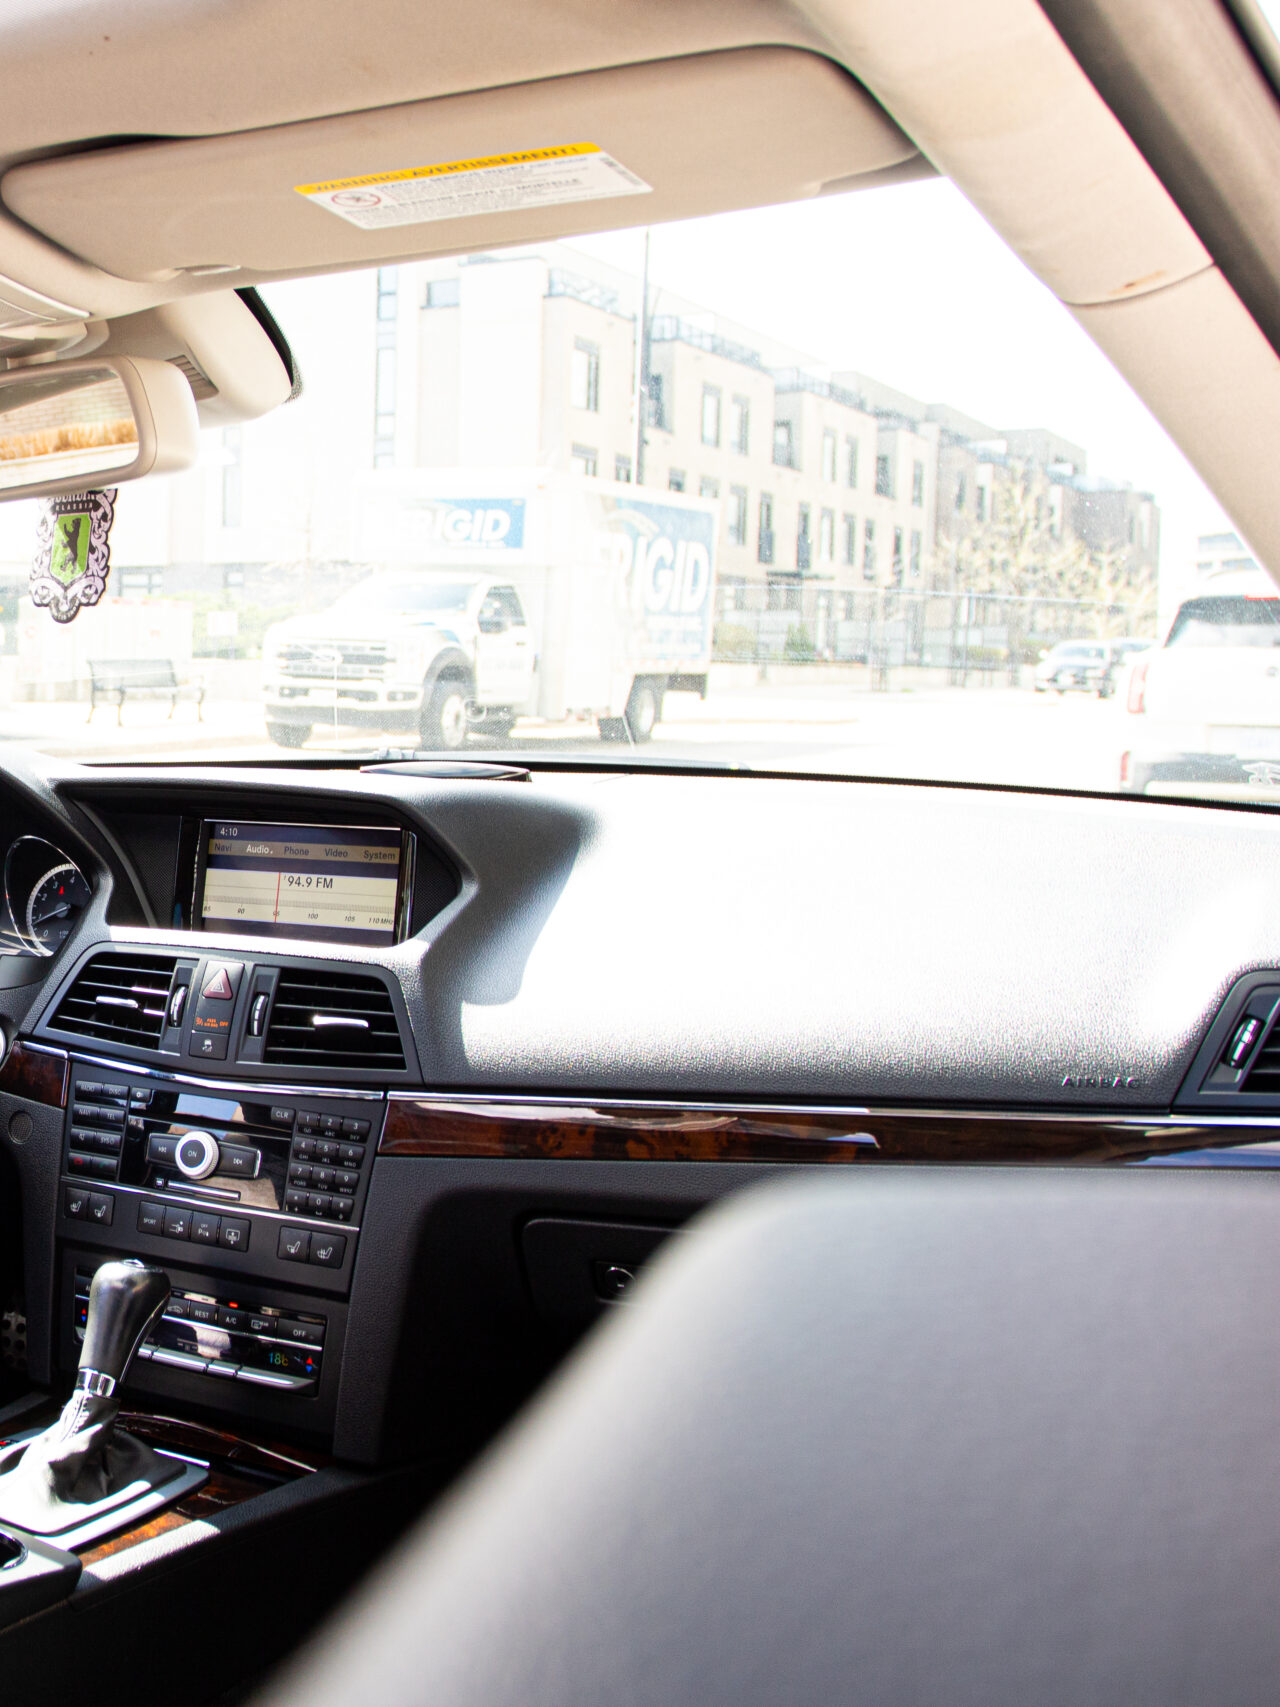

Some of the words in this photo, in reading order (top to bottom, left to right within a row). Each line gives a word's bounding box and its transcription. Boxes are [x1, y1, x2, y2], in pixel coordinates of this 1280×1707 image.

[219, 827, 238, 837] 4:10
[214, 842, 232, 853] Navi
[246, 843, 270, 855] Audio
[283, 846, 310, 856] Phone
[324, 848, 349, 859] Video
[363, 850, 396, 861] System
[287, 875, 313, 888] 94.9
[315, 877, 334, 889] FM
[307, 912, 319, 920] 100
[344, 915, 356, 923] 105
[1061, 1074, 1140, 1089] AIRBAG
[275, 1110, 289, 1119] CLR
[327, 1118, 333, 1126] 2
[353, 1122, 359, 1130] 3
[300, 1141, 306, 1149] 4
[323, 1144, 329, 1152] 5
[187, 1149, 198, 1159] ON
[348, 1149, 354, 1157] 6
[297, 1167, 303, 1175] 7
[319, 1171, 325, 1179] 8
[343, 1175, 349, 1183] 9
[194, 1309, 210, 1320] REST
[225, 1316, 237, 1325] A/C
[292, 1328, 307, 1338] OFF
